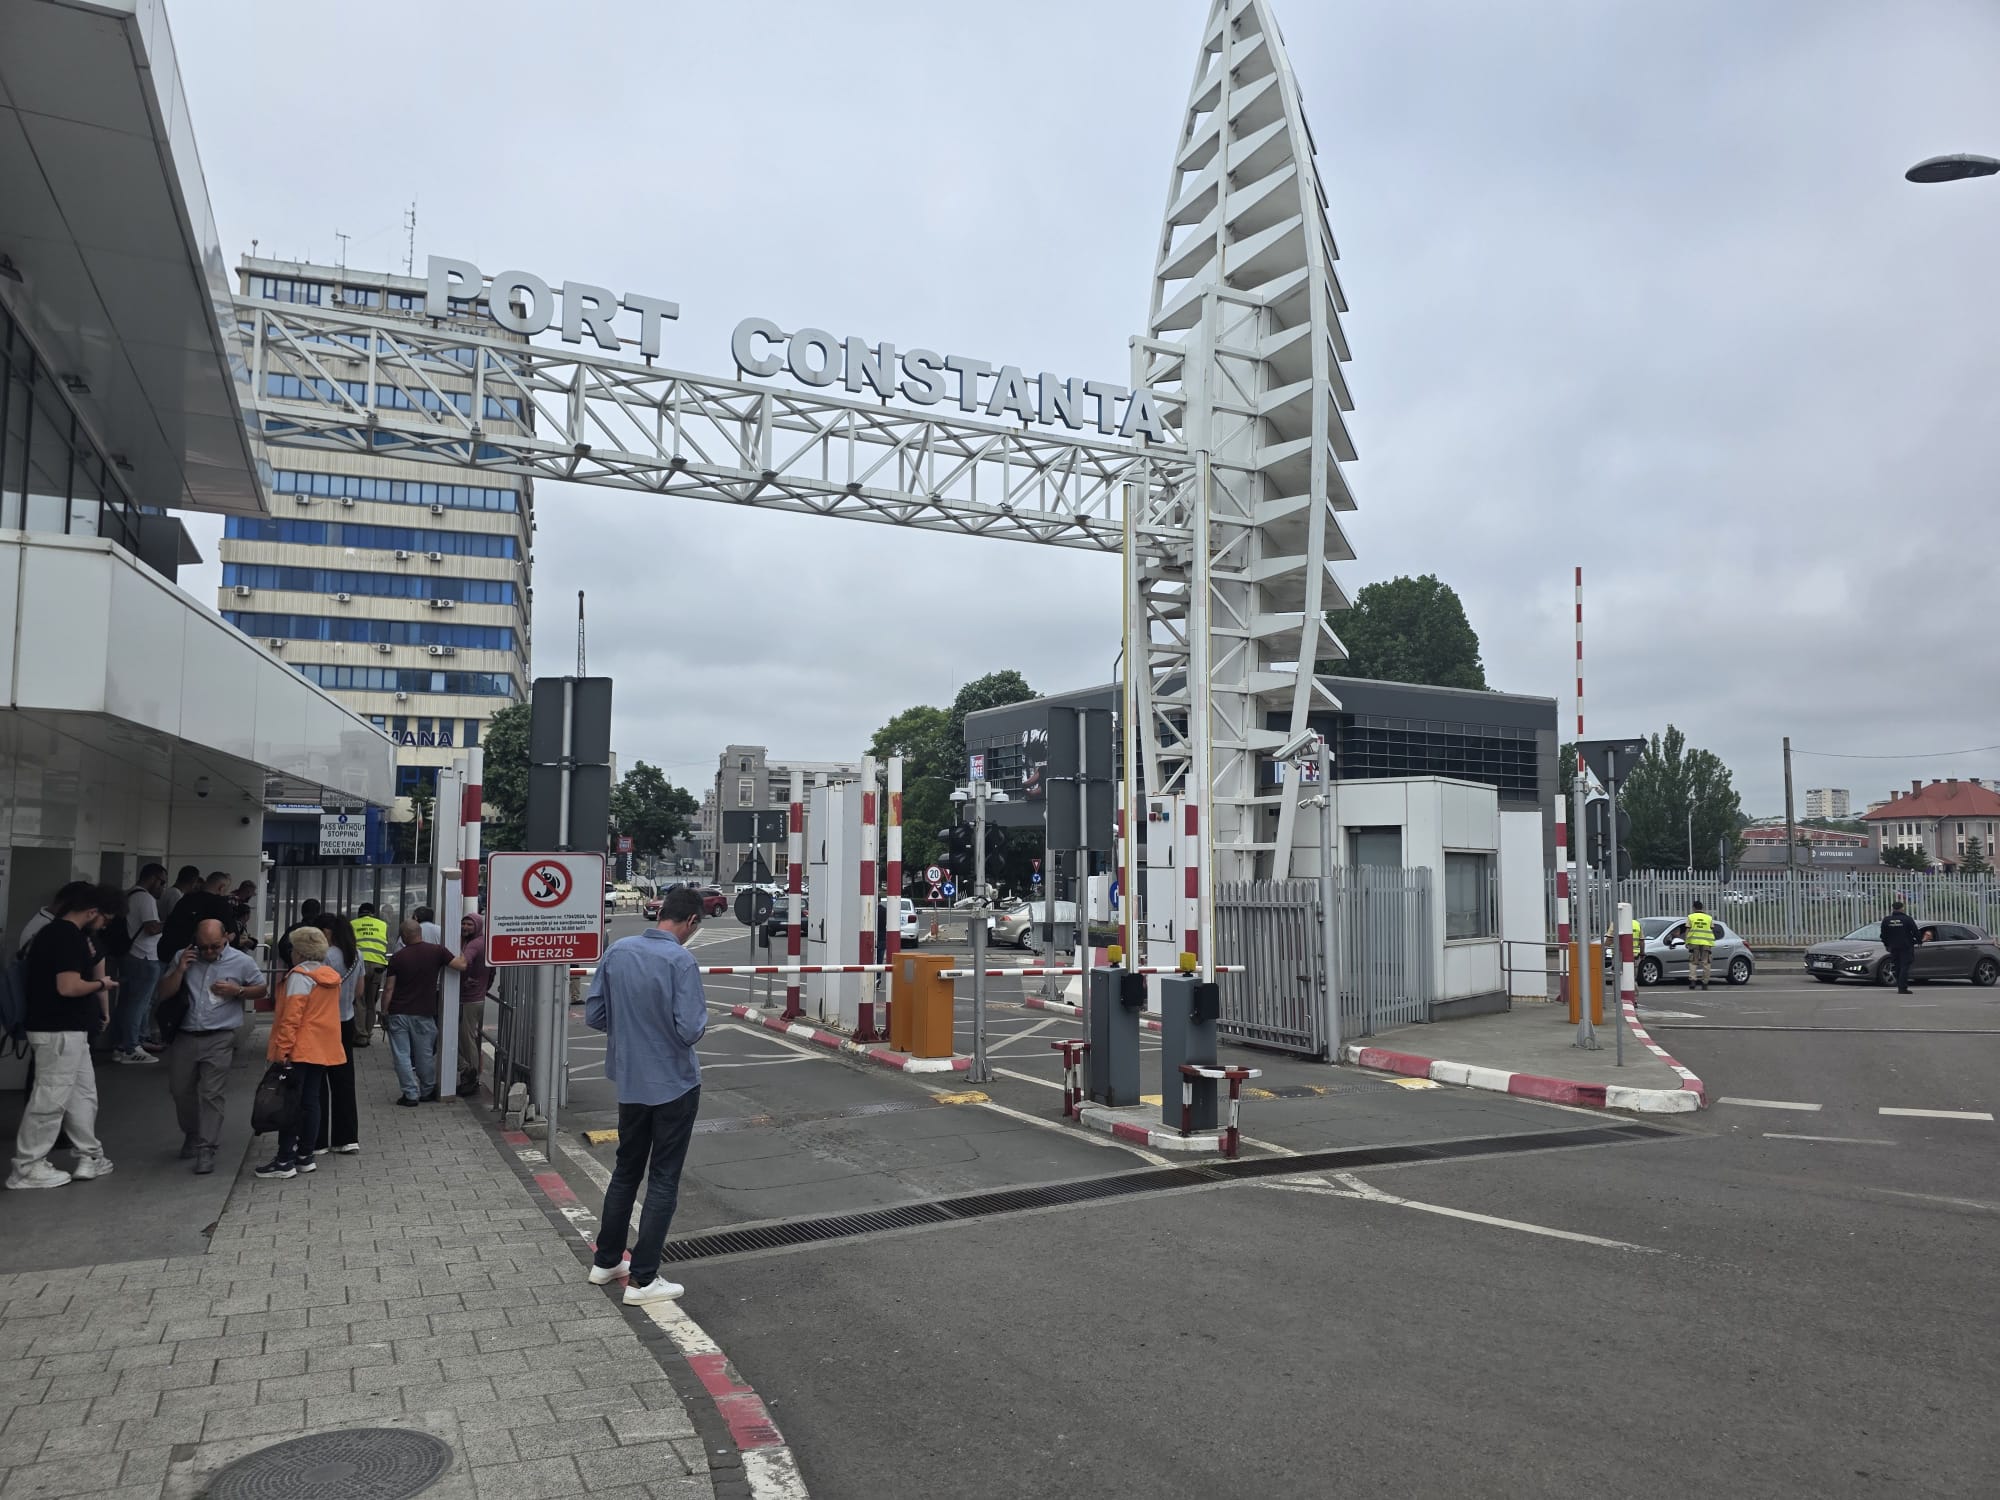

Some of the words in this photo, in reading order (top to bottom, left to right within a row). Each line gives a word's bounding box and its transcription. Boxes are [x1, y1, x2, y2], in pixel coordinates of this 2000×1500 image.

[427, 254, 679, 358] PORT
[730, 317, 1164, 443] CONSTANTA
[930, 870, 938, 878] 20
[511, 935, 580, 947] PESCUITUL
[516, 948, 574, 959] INTERZIS
